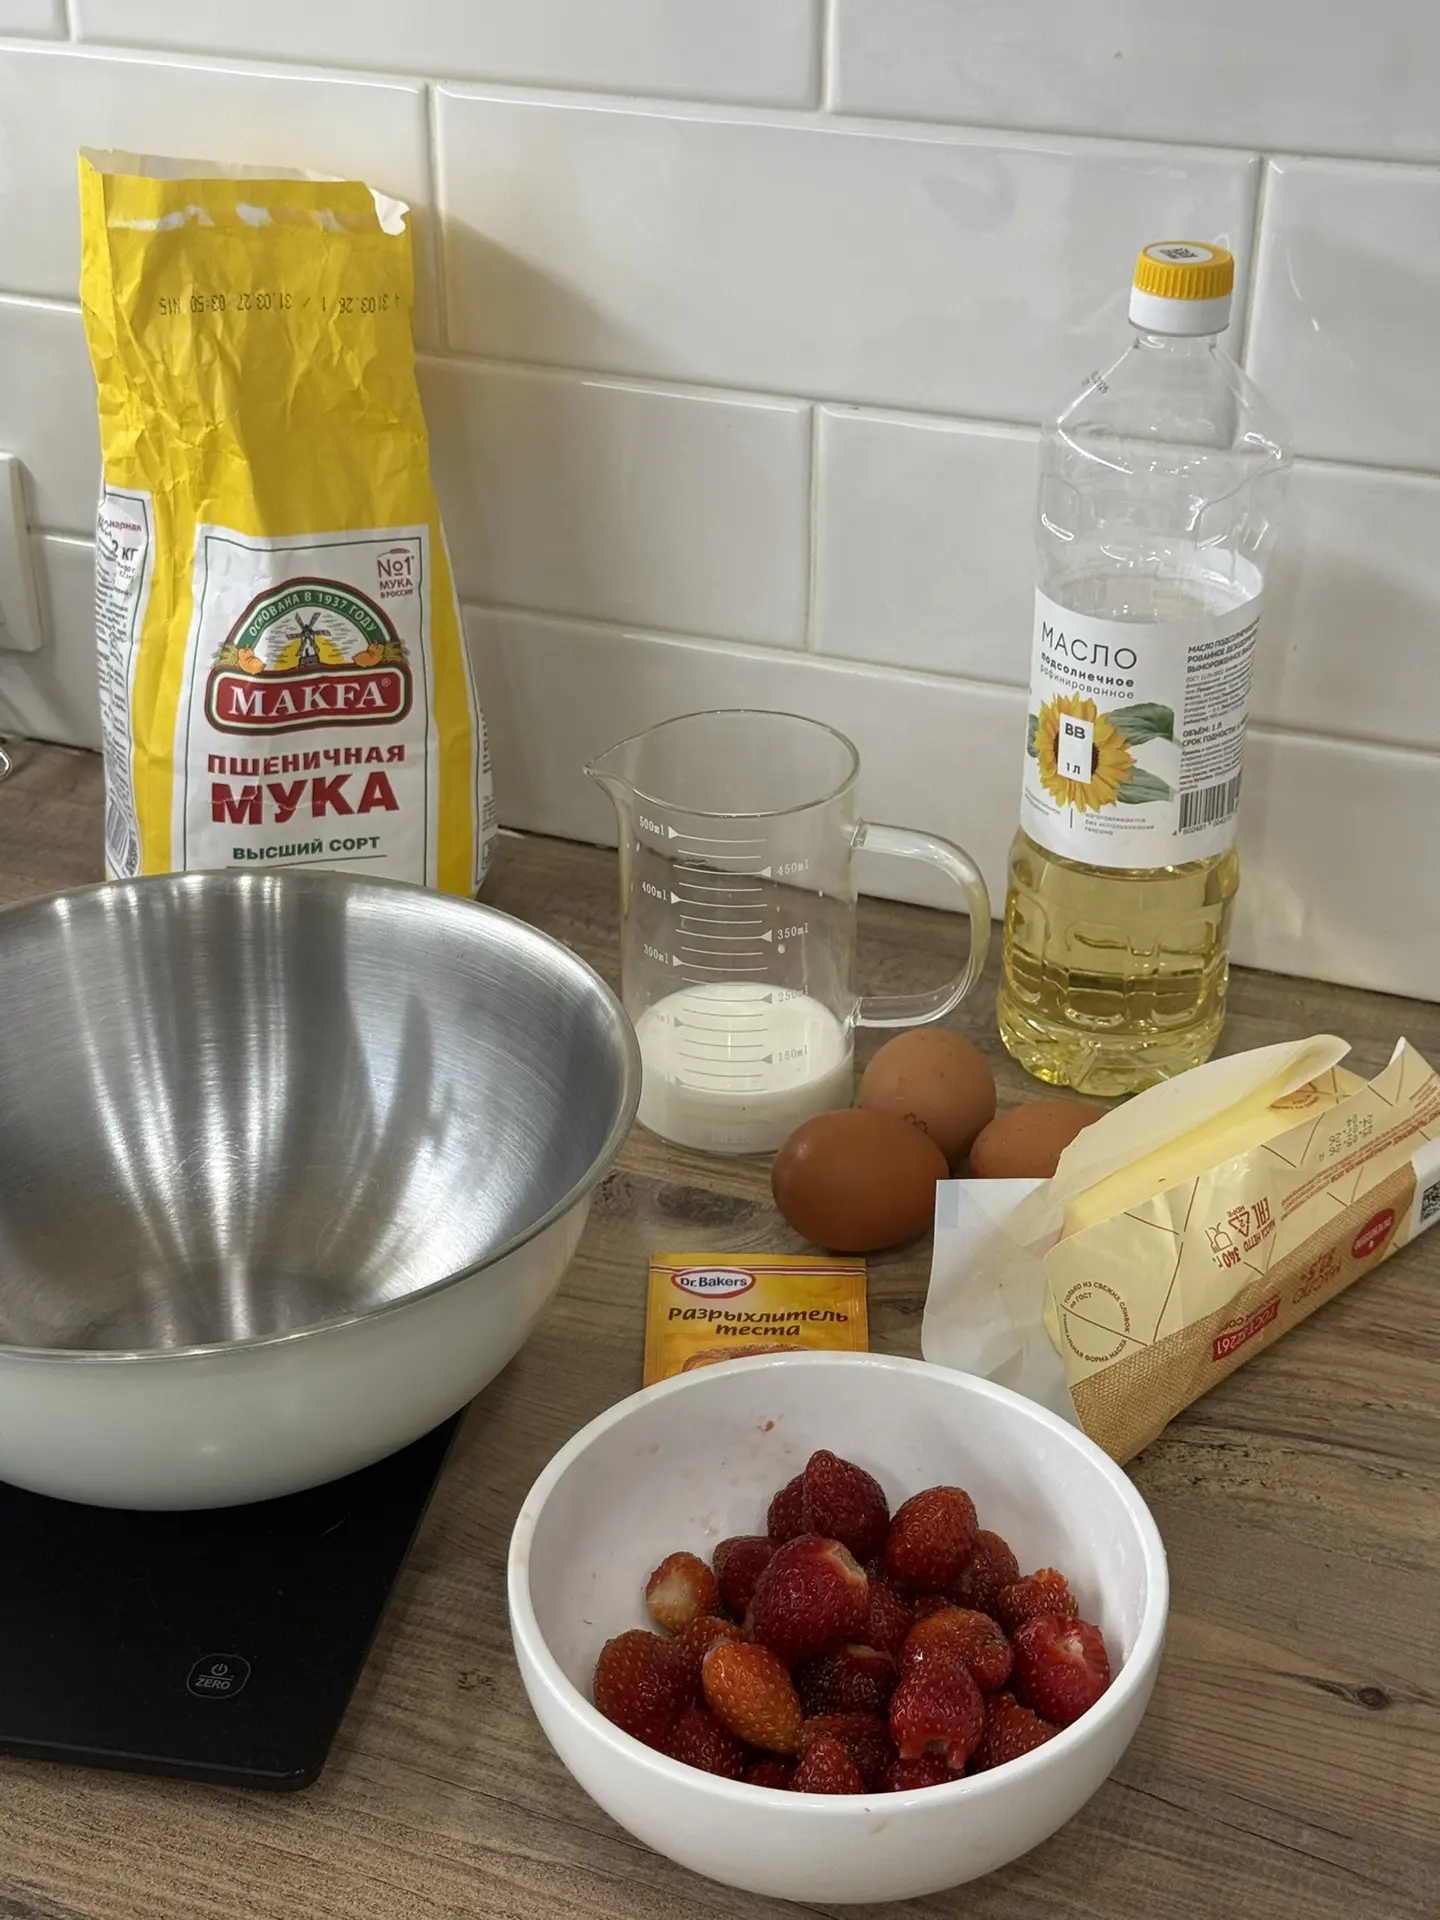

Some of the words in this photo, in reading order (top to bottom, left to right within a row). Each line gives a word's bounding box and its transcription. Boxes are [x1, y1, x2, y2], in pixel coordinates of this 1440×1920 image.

[190, 293, 227, 314] 03:50
[236, 292, 293, 311] 31.03.27
[379, 578, 414, 590] МУКА
[249, 591, 300, 637] ОСНОВАНА
[303, 591, 313, 602] В
[317, 593, 349, 609] 1937
[348, 605, 379, 632] ГОДУ
[1042, 621, 1138, 670] МАСЛО
[1041, 652, 1135, 687] подсолнечное
[1040, 664, 1135, 700] рафинированное
[228, 680, 387, 718] MAKFA
[1182, 736, 1201, 747] СРОК
[207, 744, 406, 776] ПШЕНИЧНАЯ
[211, 770, 400, 825] МУКА
[638, 816, 666, 836] 500ml
[232, 838, 324, 860] ВЫСШИЙ
[329, 836, 381, 852] СОРТ
[776, 859, 810, 877] 450ml
[641, 882, 668, 901] 400ml
[777, 922, 810, 940] 350ml
[643, 943, 670, 964] 300ml
[778, 1044, 809, 1062] 150ml
[1226, 1204, 1245, 1219] HDPE
[1221, 1245, 1242, 1268] 340
[680, 1277, 697, 1288] Dr.
[698, 1275, 748, 1288] Bakers
[1075, 1292, 1092, 1302] ГОСТ
[1093, 1282, 1121, 1302] СВЕЖИХ
[1119, 1301, 1131, 1333] СЛИВОК
[715, 1323, 811, 1337] теста
[1084, 1354, 1109, 1363] ФОРМА
[1108, 1340, 1127, 1358] МАСЛА
[194, 1677, 232, 1690] ZERO
